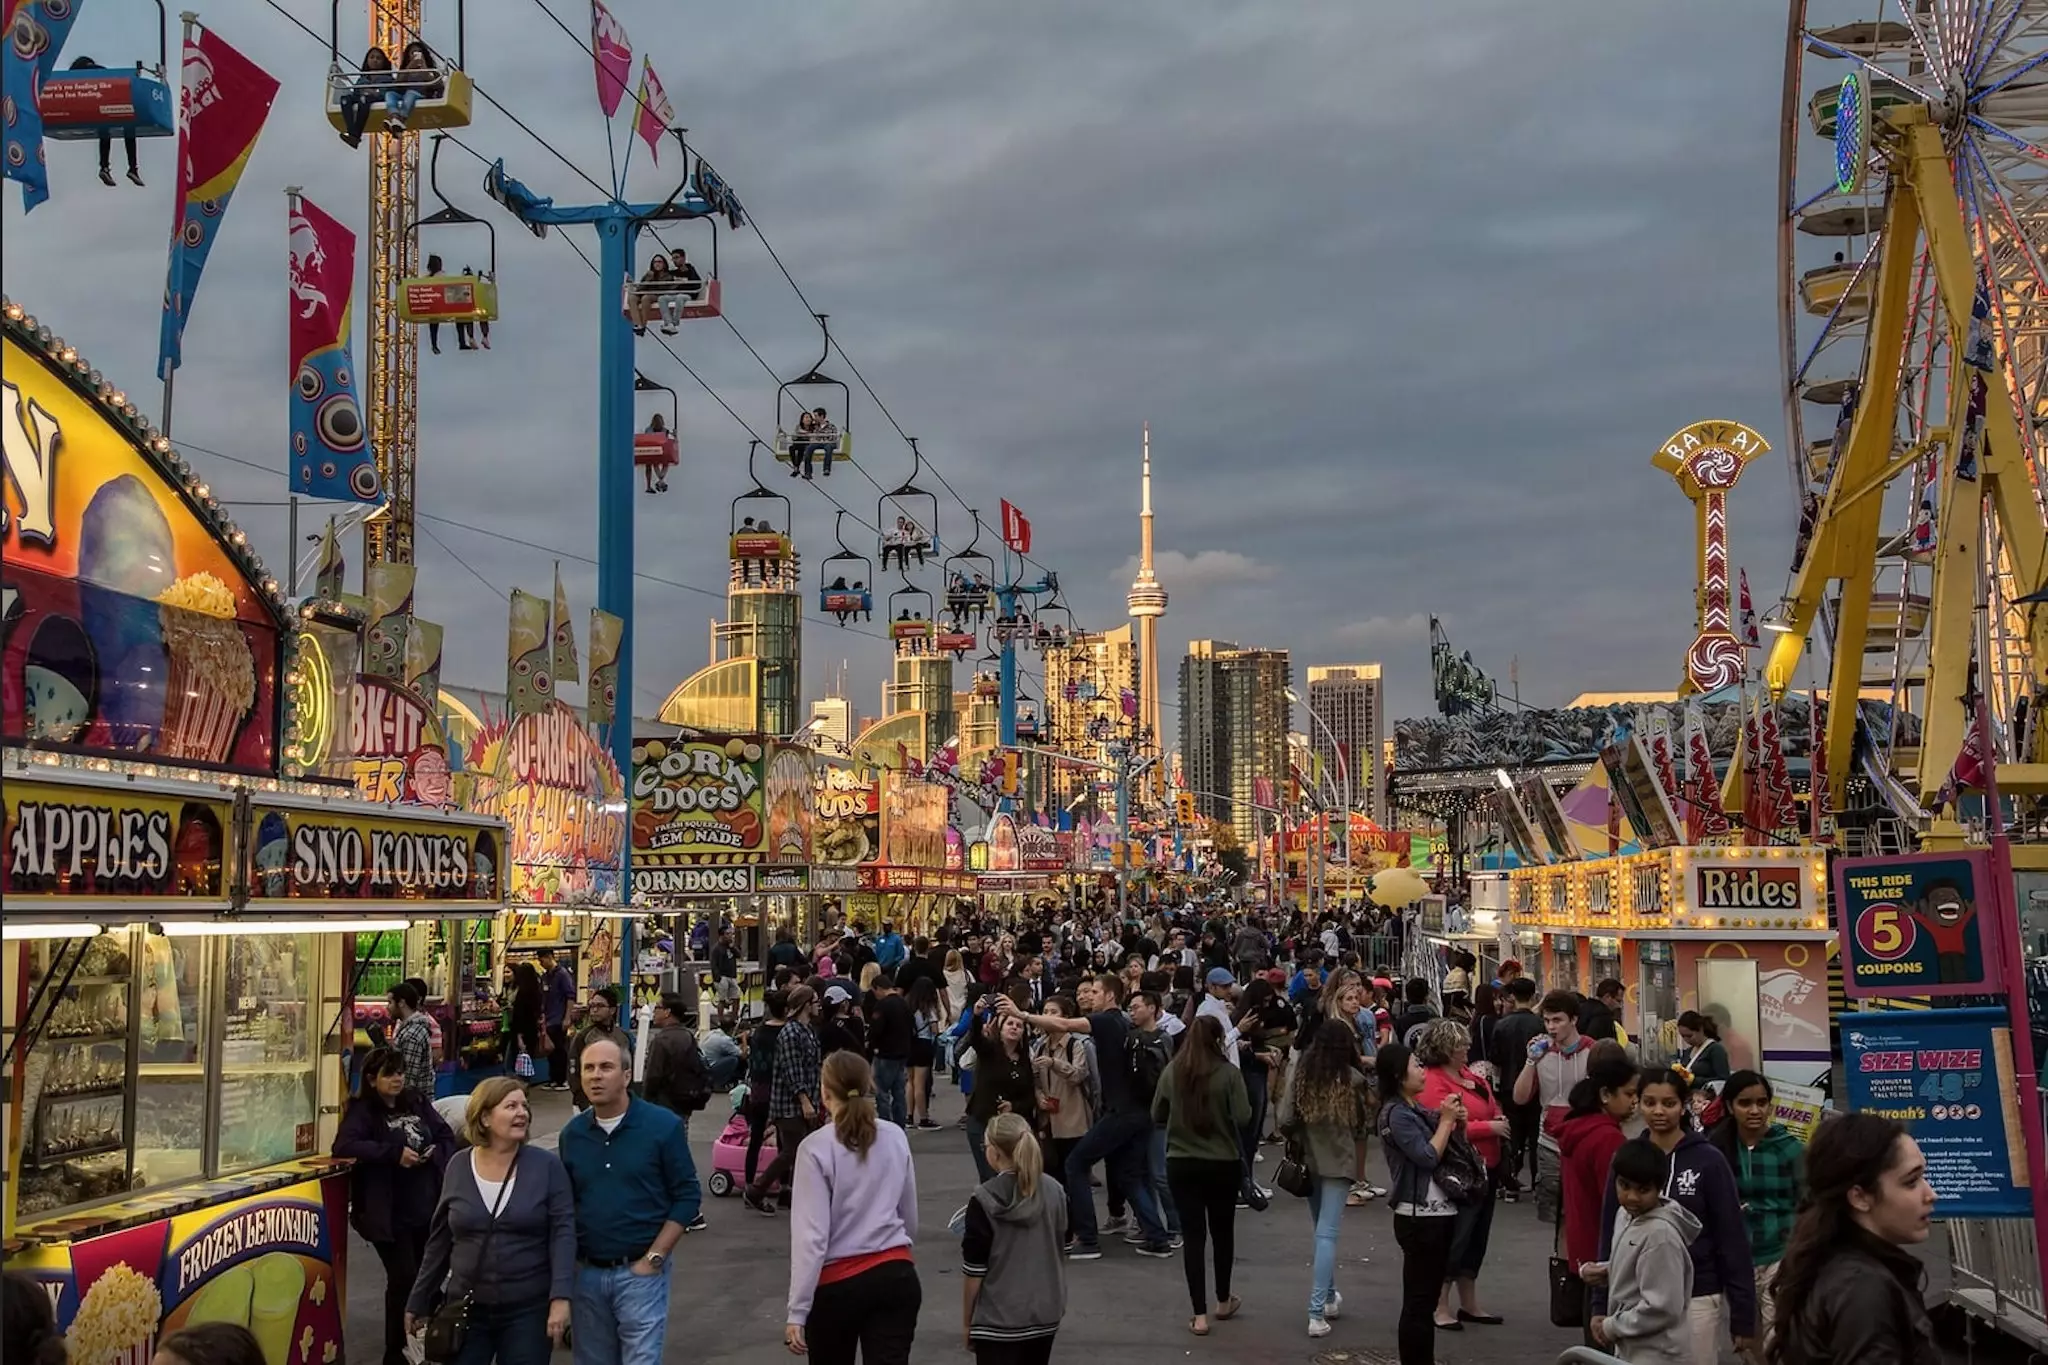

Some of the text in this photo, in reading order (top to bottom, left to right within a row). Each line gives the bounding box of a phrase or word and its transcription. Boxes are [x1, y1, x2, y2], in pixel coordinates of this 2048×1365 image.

[151, 88, 164, 101] 64
[1666, 424, 1760, 461] BANZAI
[634, 749, 758, 798] CORN
[653, 786, 739, 810] DOGS
[650, 828, 743, 849] LEMONADE
[655, 821, 732, 833] FRESH SQUEEZED
[11, 803, 170, 880] APPLES
[293, 824, 469, 888] SNO KONES
[1704, 868, 1797, 908] Rides
[1849, 874, 1913, 888] THIS RIDE
[1861, 887, 1904, 900] TAKES
[1873, 911, 1903, 951] 5
[1857, 962, 1924, 975] COUPONS
[1859, 1049, 1982, 1072] SIZE WIZE
[178, 1206, 320, 1294] FROZEN LEMONADE
